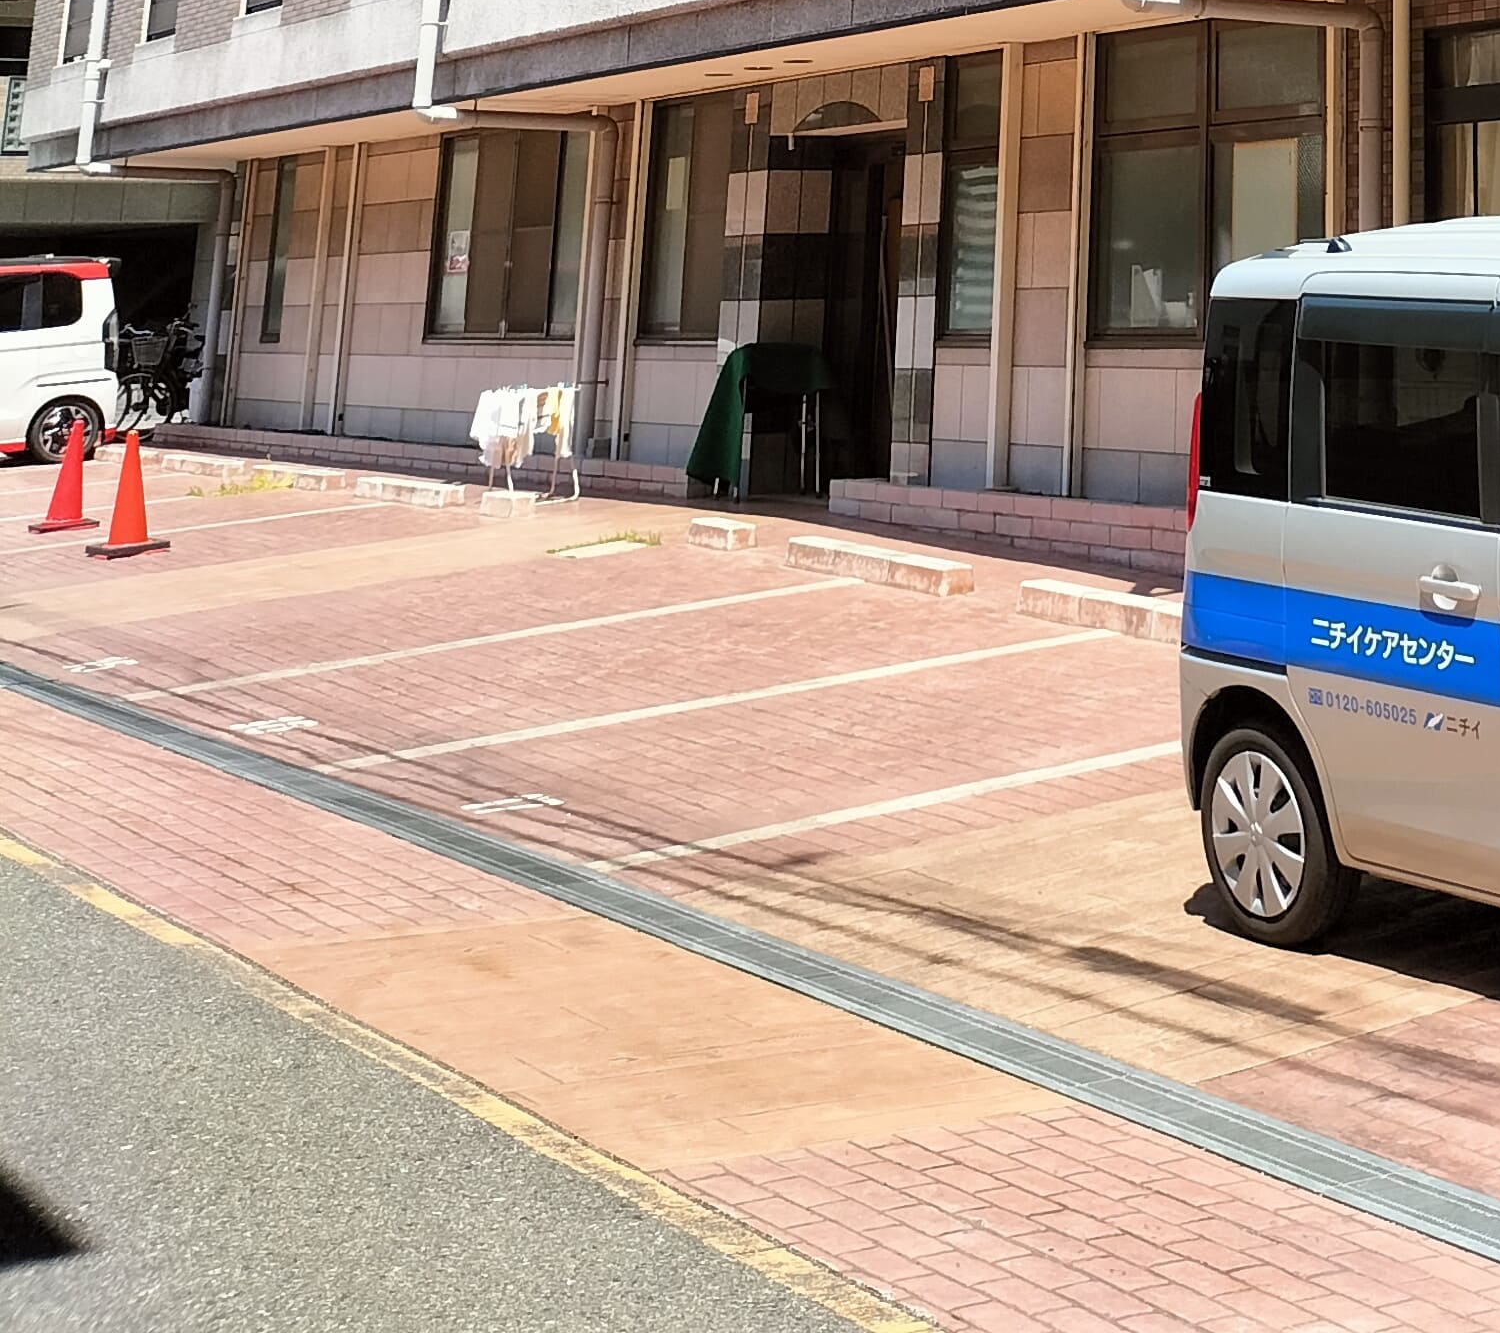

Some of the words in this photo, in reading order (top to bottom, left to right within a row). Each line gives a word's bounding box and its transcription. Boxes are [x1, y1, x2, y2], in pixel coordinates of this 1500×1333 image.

[1311, 618, 1475, 670] ニチイケアセンター
[1325, 691, 1417, 726] 0120-605025
[1446, 715, 1481, 740] ニチイ
